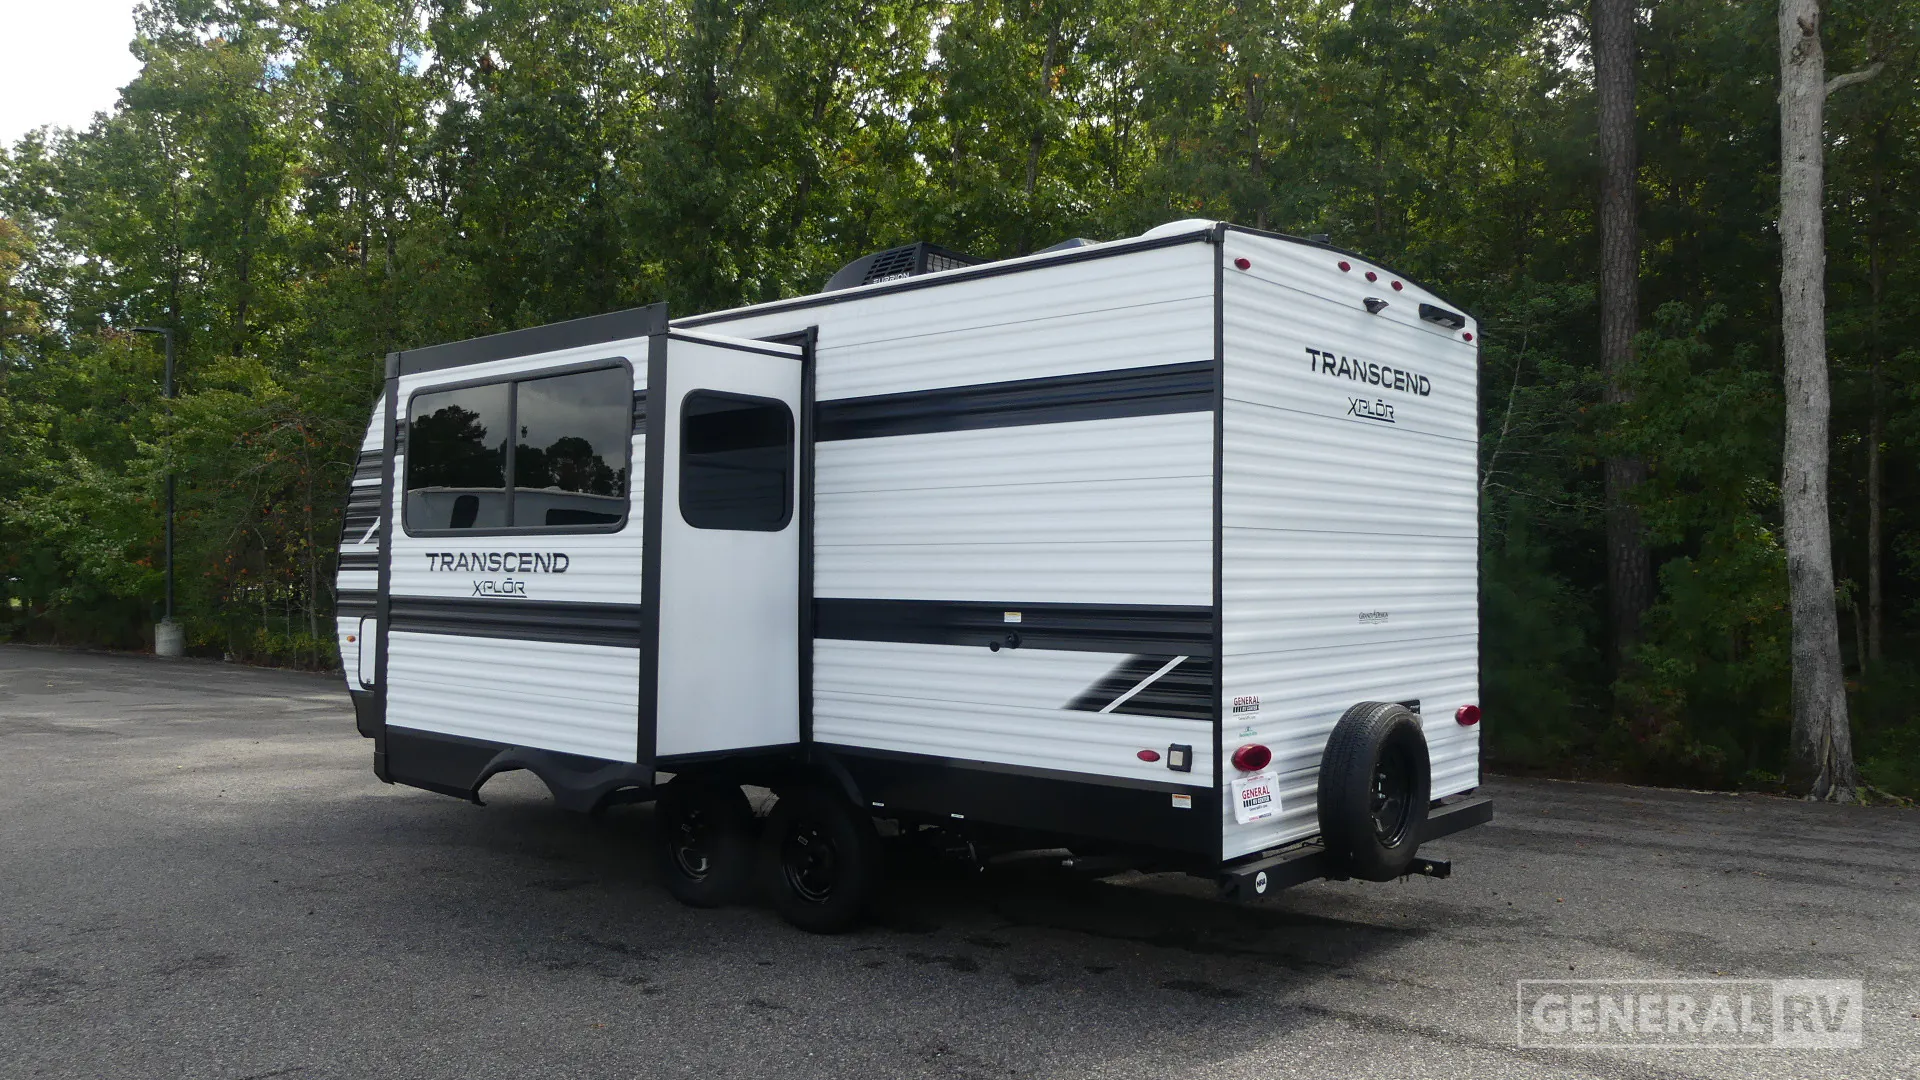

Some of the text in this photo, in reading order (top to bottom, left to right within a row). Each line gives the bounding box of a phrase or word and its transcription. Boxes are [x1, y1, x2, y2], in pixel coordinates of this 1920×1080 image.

[1305, 347, 1431, 396] TRANSCEND
[425, 552, 570, 573] TRANSCEND
[1234, 696, 1260, 706] GENERAL
[1241, 785, 1270, 799] GENERAL
